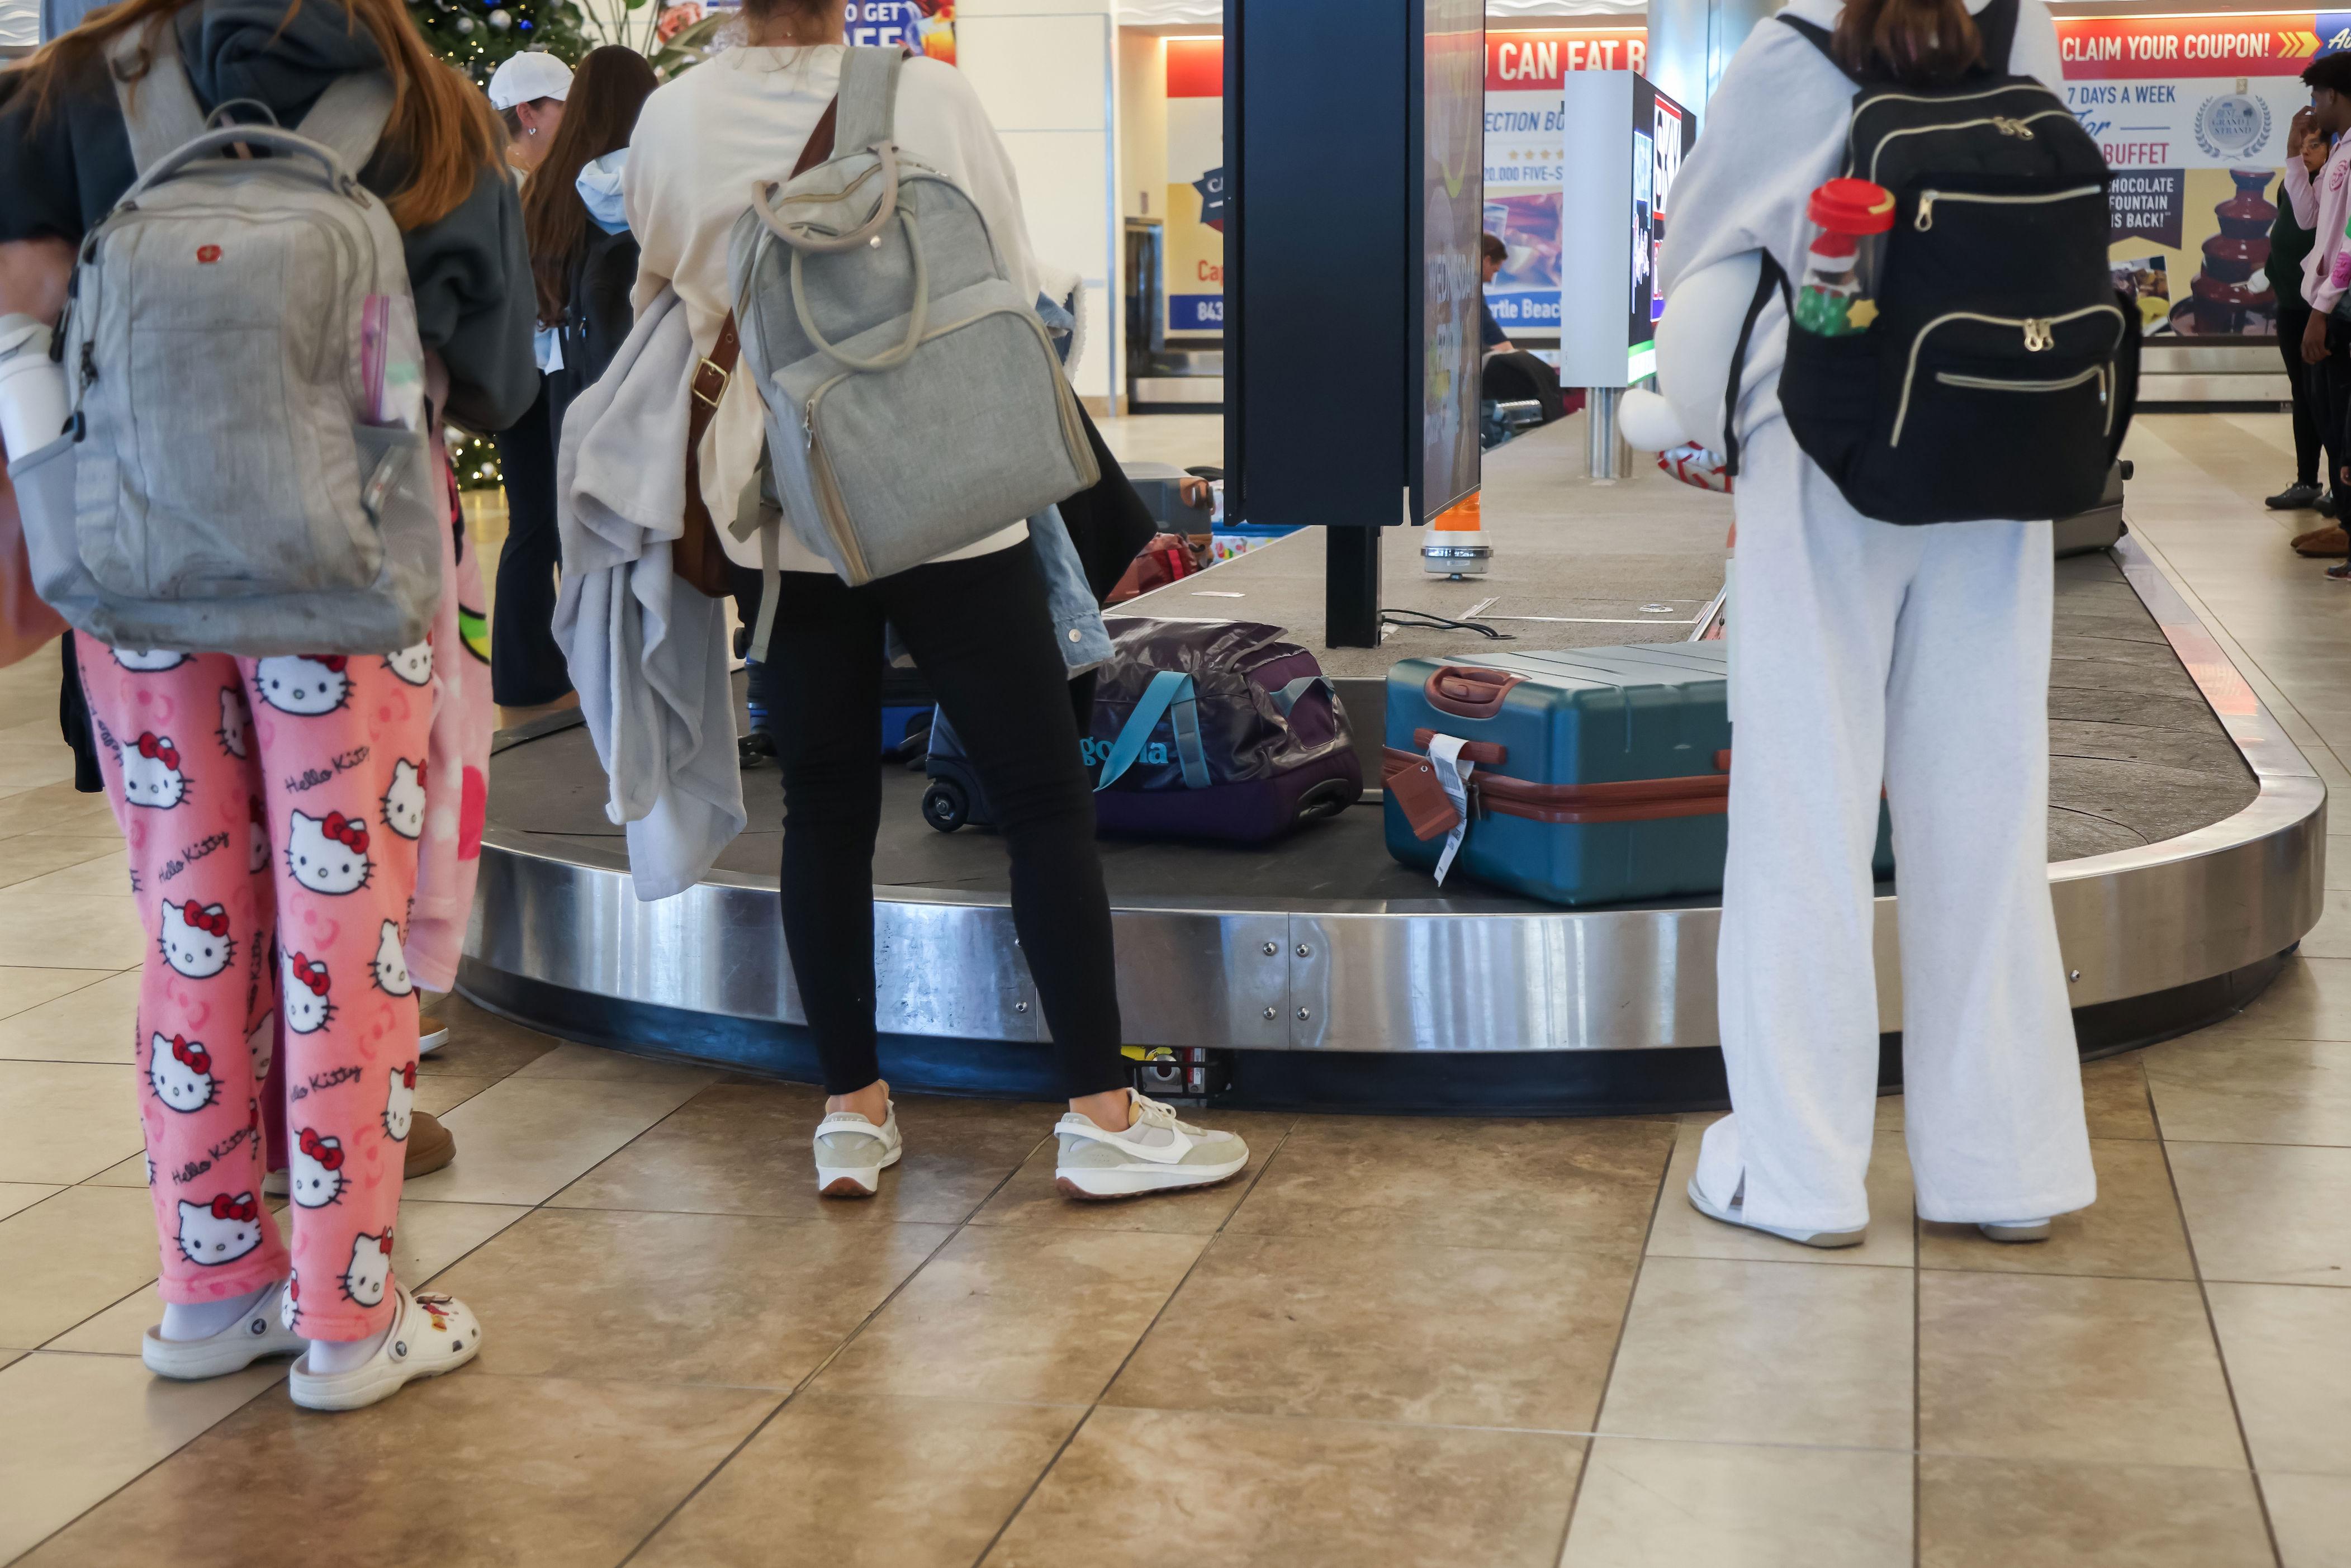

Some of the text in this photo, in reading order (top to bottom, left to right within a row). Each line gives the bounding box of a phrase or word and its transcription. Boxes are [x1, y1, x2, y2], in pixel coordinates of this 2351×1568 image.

[864, 2, 900, 22] GET
[2062, 32, 2271, 61] CLAIM YOUR COUPON!
[1499, 41, 1557, 80] CAN
[1567, 40, 1619, 70] EAT
[2068, 86, 2176, 104] 7 DAYS A WEEK
[2103, 143, 2170, 164] BUFFET
[2109, 195, 2168, 210] FOUNTAIN
[2111, 212, 2164, 228] IS BACK!
[285, 768, 332, 794] Hello
[181, 831, 230, 864] Kitty
[309, 1064, 363, 1092] Kitty
[171, 1160, 211, 1186] Hello
